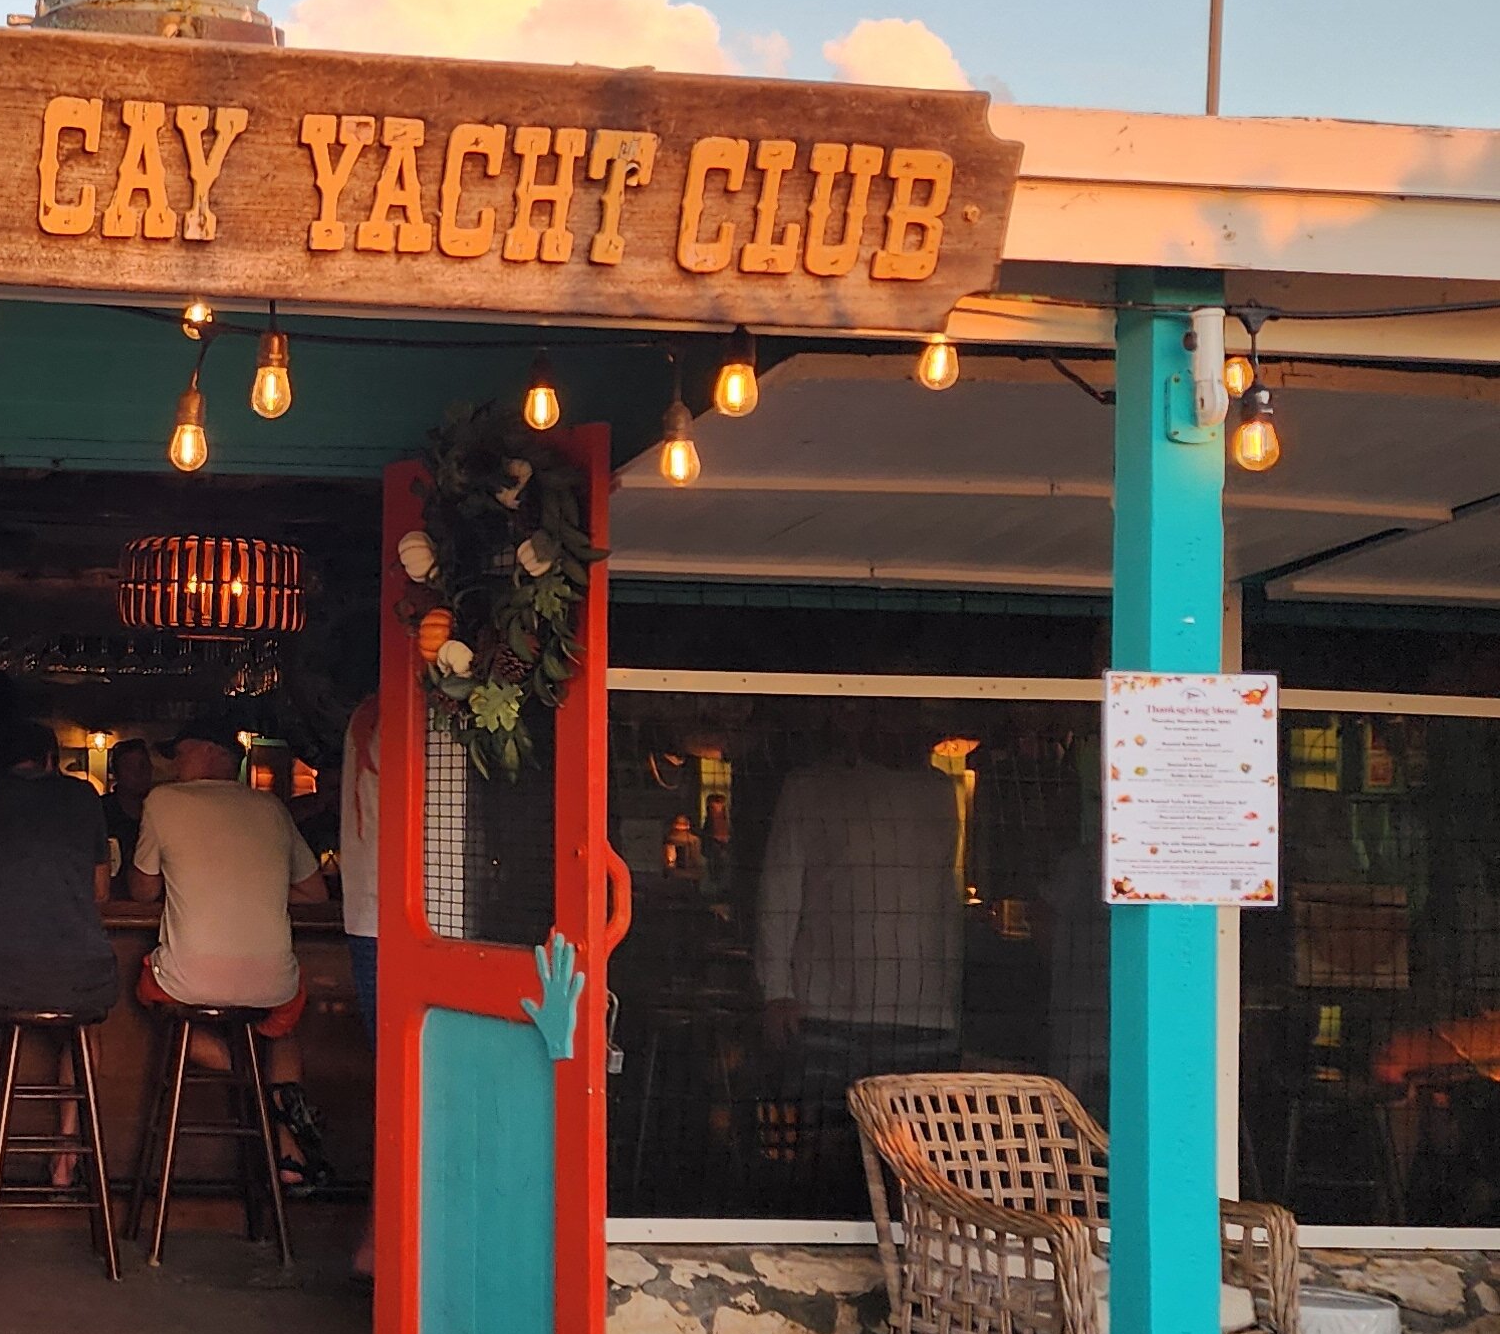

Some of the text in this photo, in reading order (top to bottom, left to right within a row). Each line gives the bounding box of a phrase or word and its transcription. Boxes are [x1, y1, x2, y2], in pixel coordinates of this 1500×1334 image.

[38, 95, 249, 243] CAY
[301, 111, 660, 266] YACHT
[677, 134, 959, 281] CLUB
[1146, 704, 1238, 716] Thanksgiving Menu
